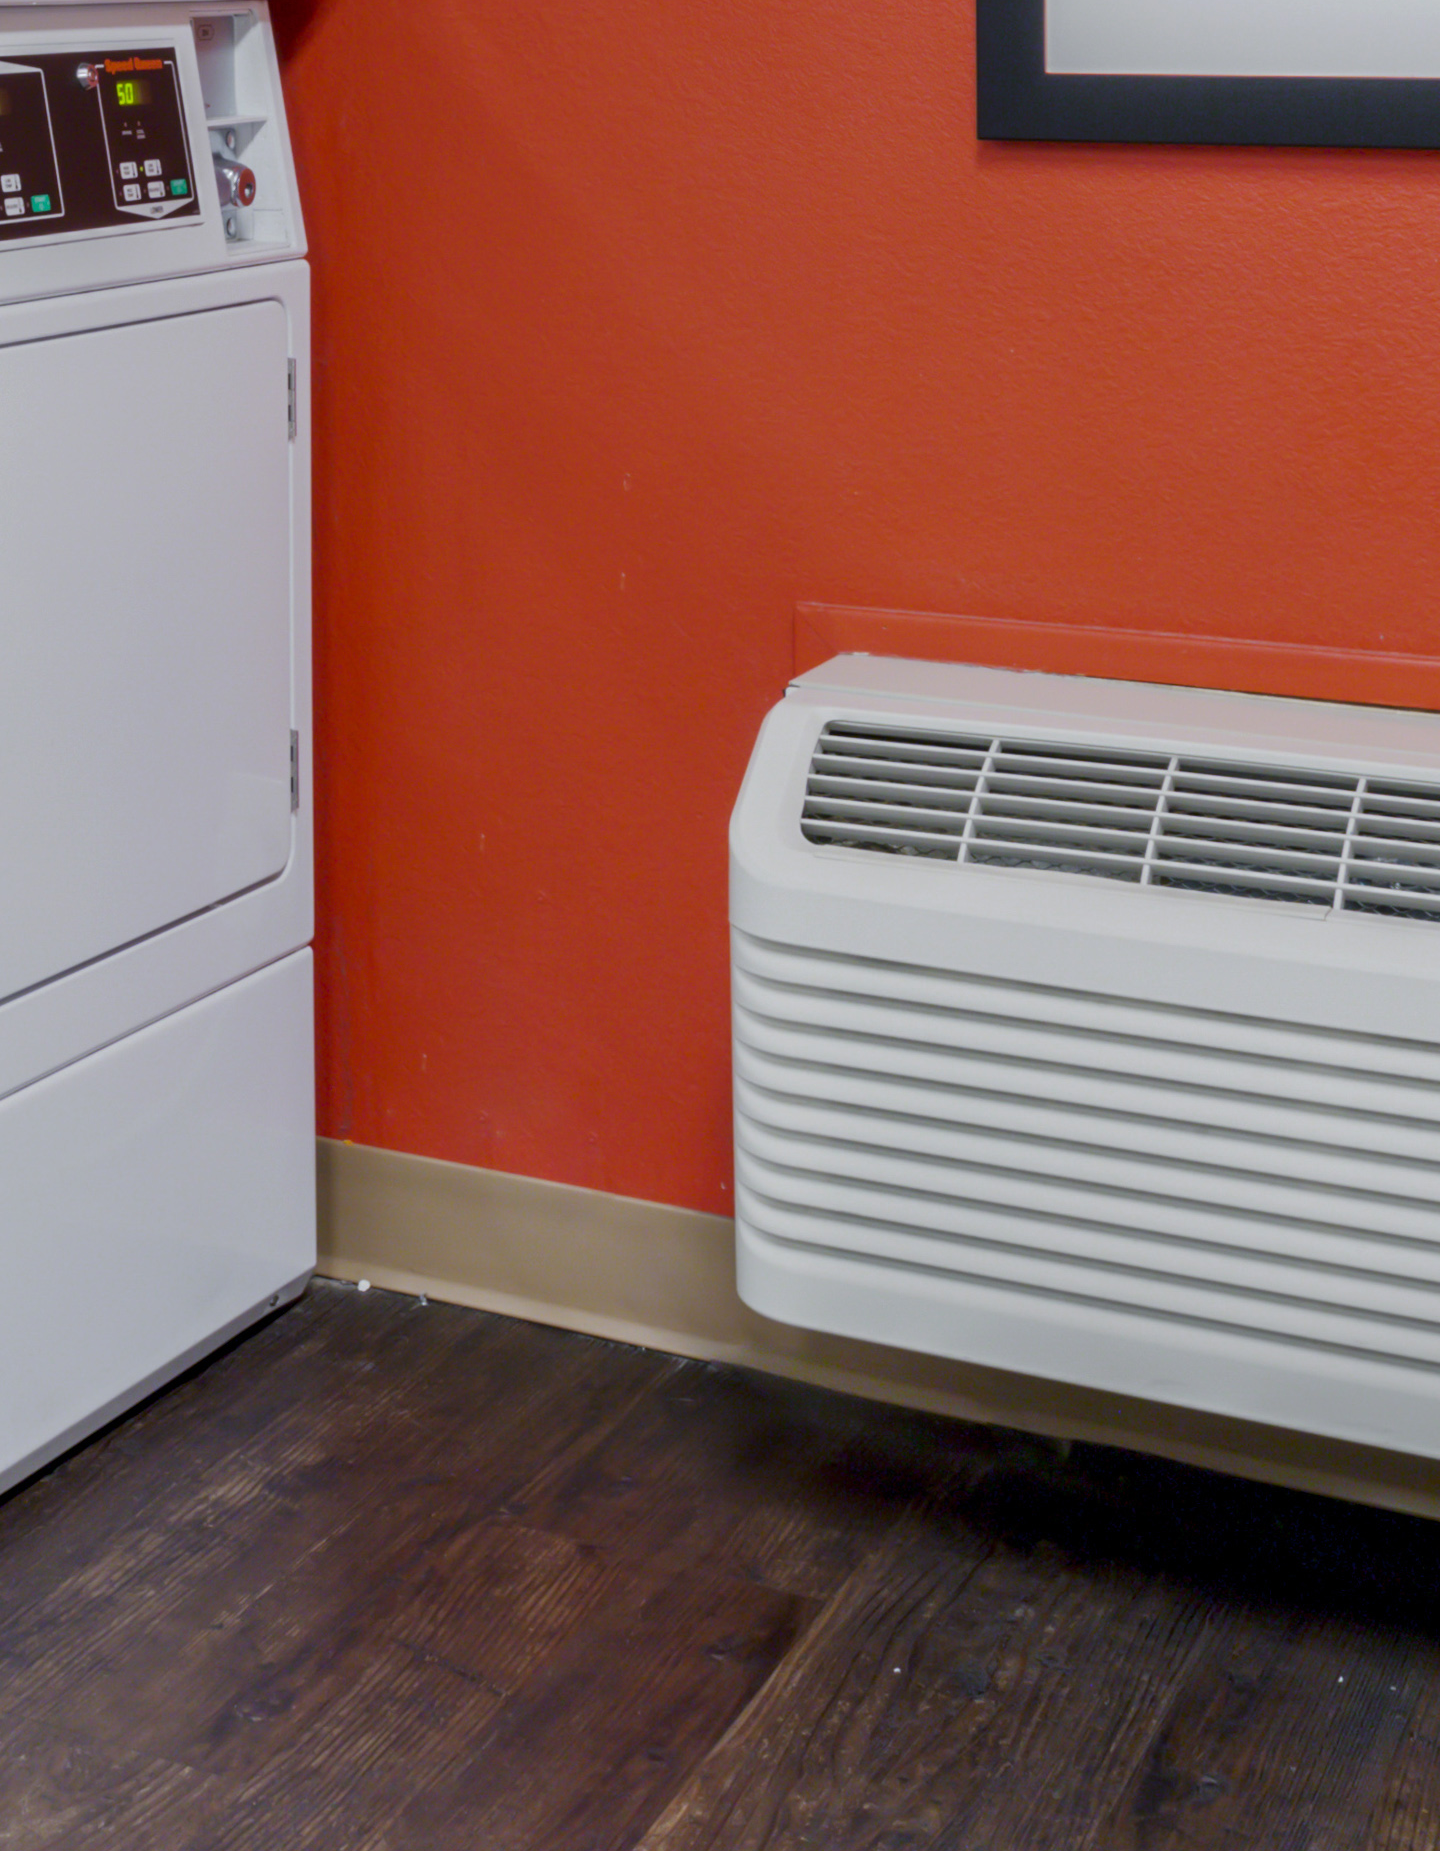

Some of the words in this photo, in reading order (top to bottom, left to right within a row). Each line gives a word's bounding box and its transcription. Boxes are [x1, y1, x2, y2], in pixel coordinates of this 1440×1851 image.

[104, 58, 133, 74] Speed
[134, 58, 163, 71] Queen
[116, 83, 134, 106] 50
